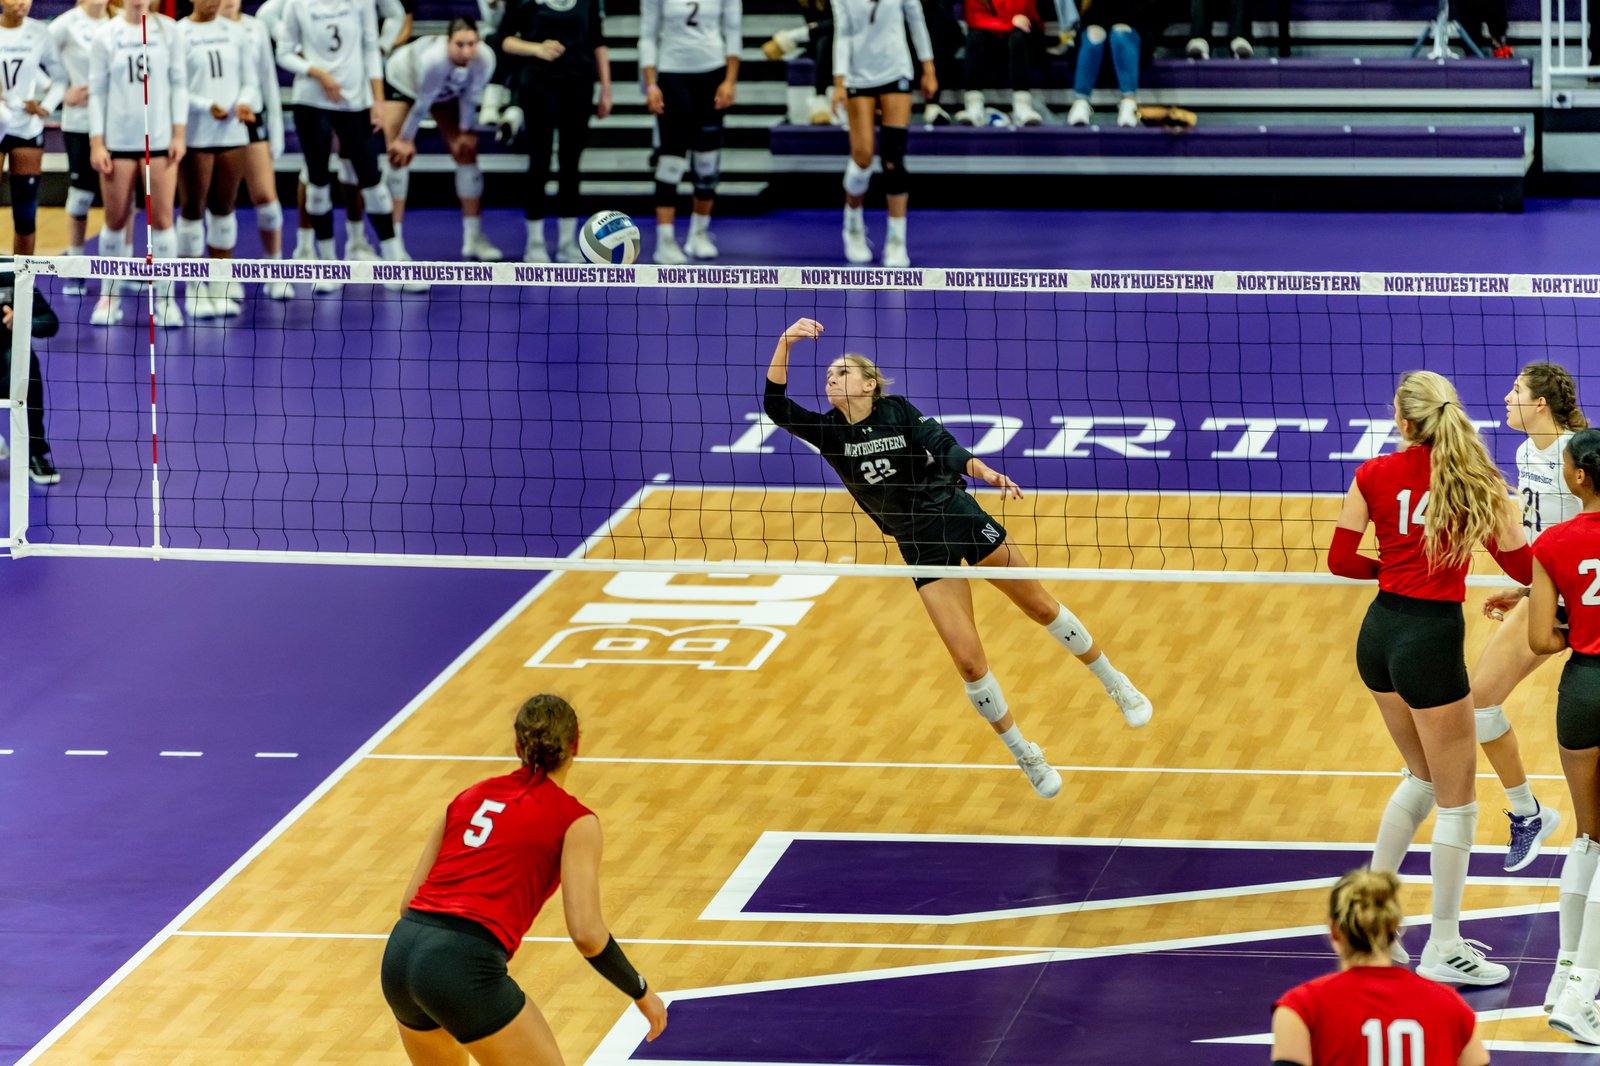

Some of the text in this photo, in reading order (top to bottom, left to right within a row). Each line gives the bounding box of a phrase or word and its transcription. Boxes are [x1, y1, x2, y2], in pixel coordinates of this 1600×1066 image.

[685, 2, 699, 27] 2
[326, 23, 342, 53] 3
[3, 58, 23, 90] 17
[128, 53, 151, 84] 18
[208, 49, 223, 79] 11
[90, 259, 1600, 294] NORTHWESTERN NORTHWESTERN NORTHWESTERN NORTHWESTERN NORTHWESTERN NORTHWESTERN NORTHWESTERN NORTHWESTERN NORTHWESTERN NORTHWESTERN NORTHW
[844, 434, 907, 457] NRTHWESTERN
[1522, 487, 1541, 532] 21
[463, 799, 507, 848] 5
[1361, 1018, 1425, 1066] 10
